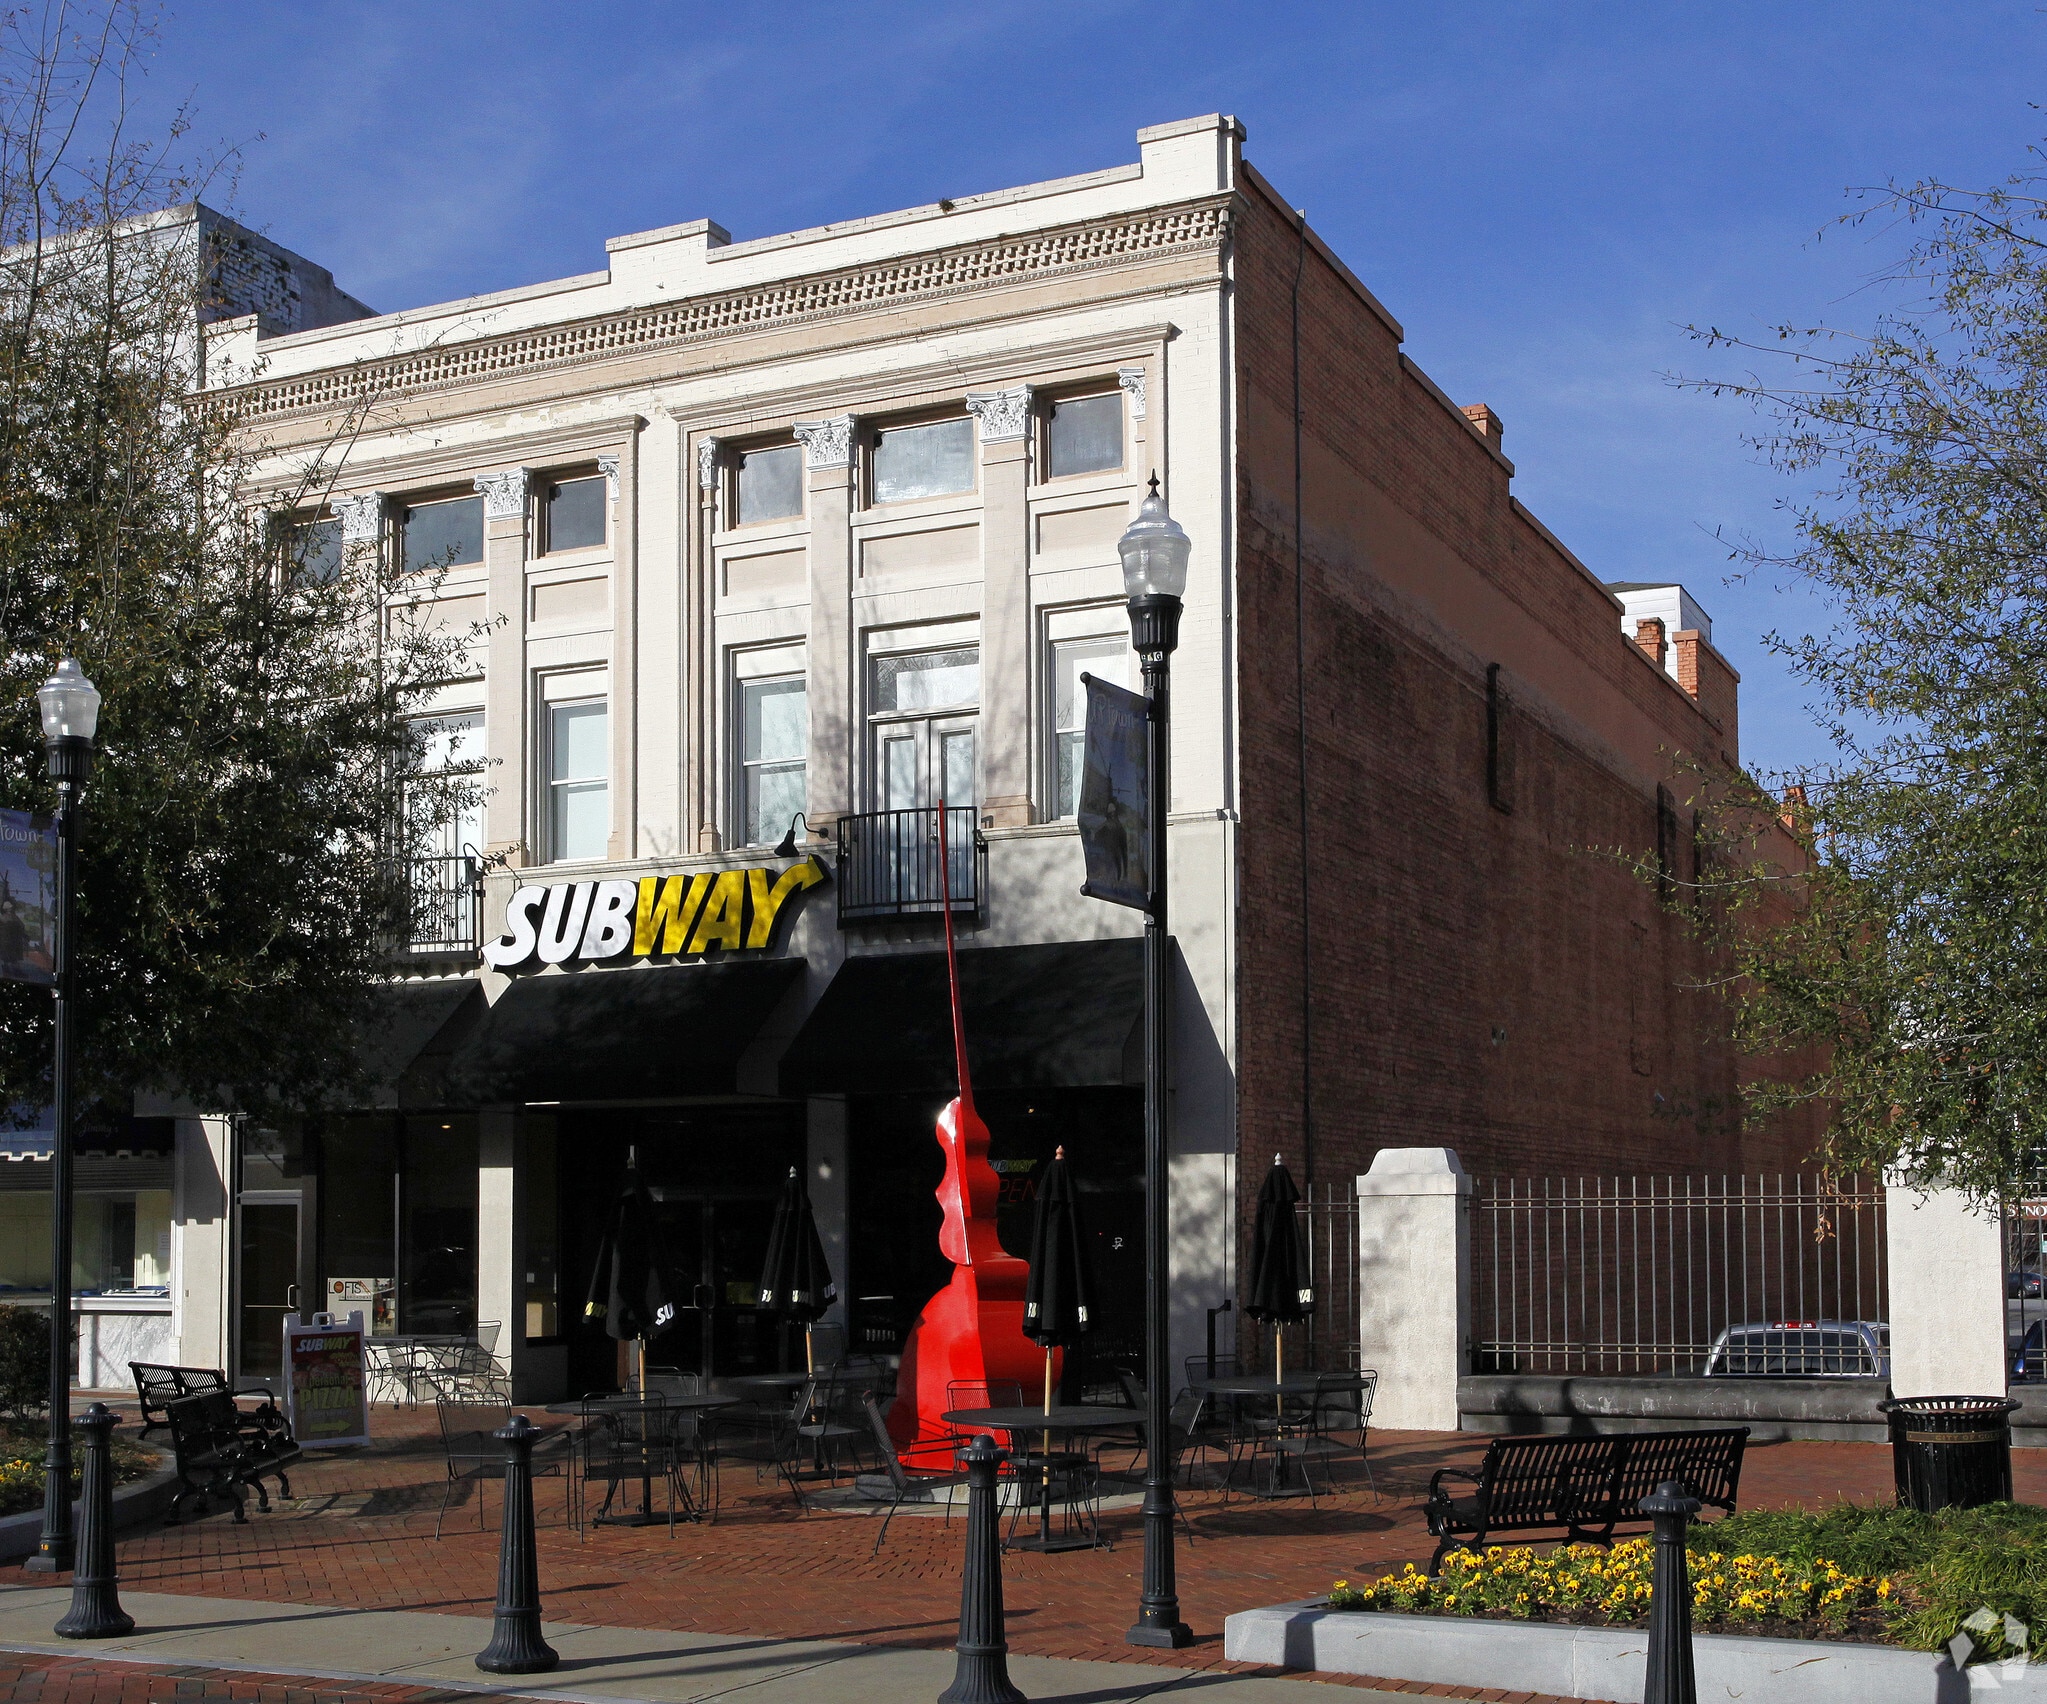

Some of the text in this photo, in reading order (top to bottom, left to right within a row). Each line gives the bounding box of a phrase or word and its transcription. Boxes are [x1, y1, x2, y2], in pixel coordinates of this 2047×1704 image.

[481, 853, 826, 972] SUBWAY
[999, 1178, 1037, 1203] PEN
[2007, 1203, 2047, 1218] SNO
[328, 1280, 362, 1297] LOFTS
[296, 1336, 356, 1353] SUBWAY
[300, 1386, 356, 1411] PIZZA
[1935, 1433, 1959, 1441] CITY
